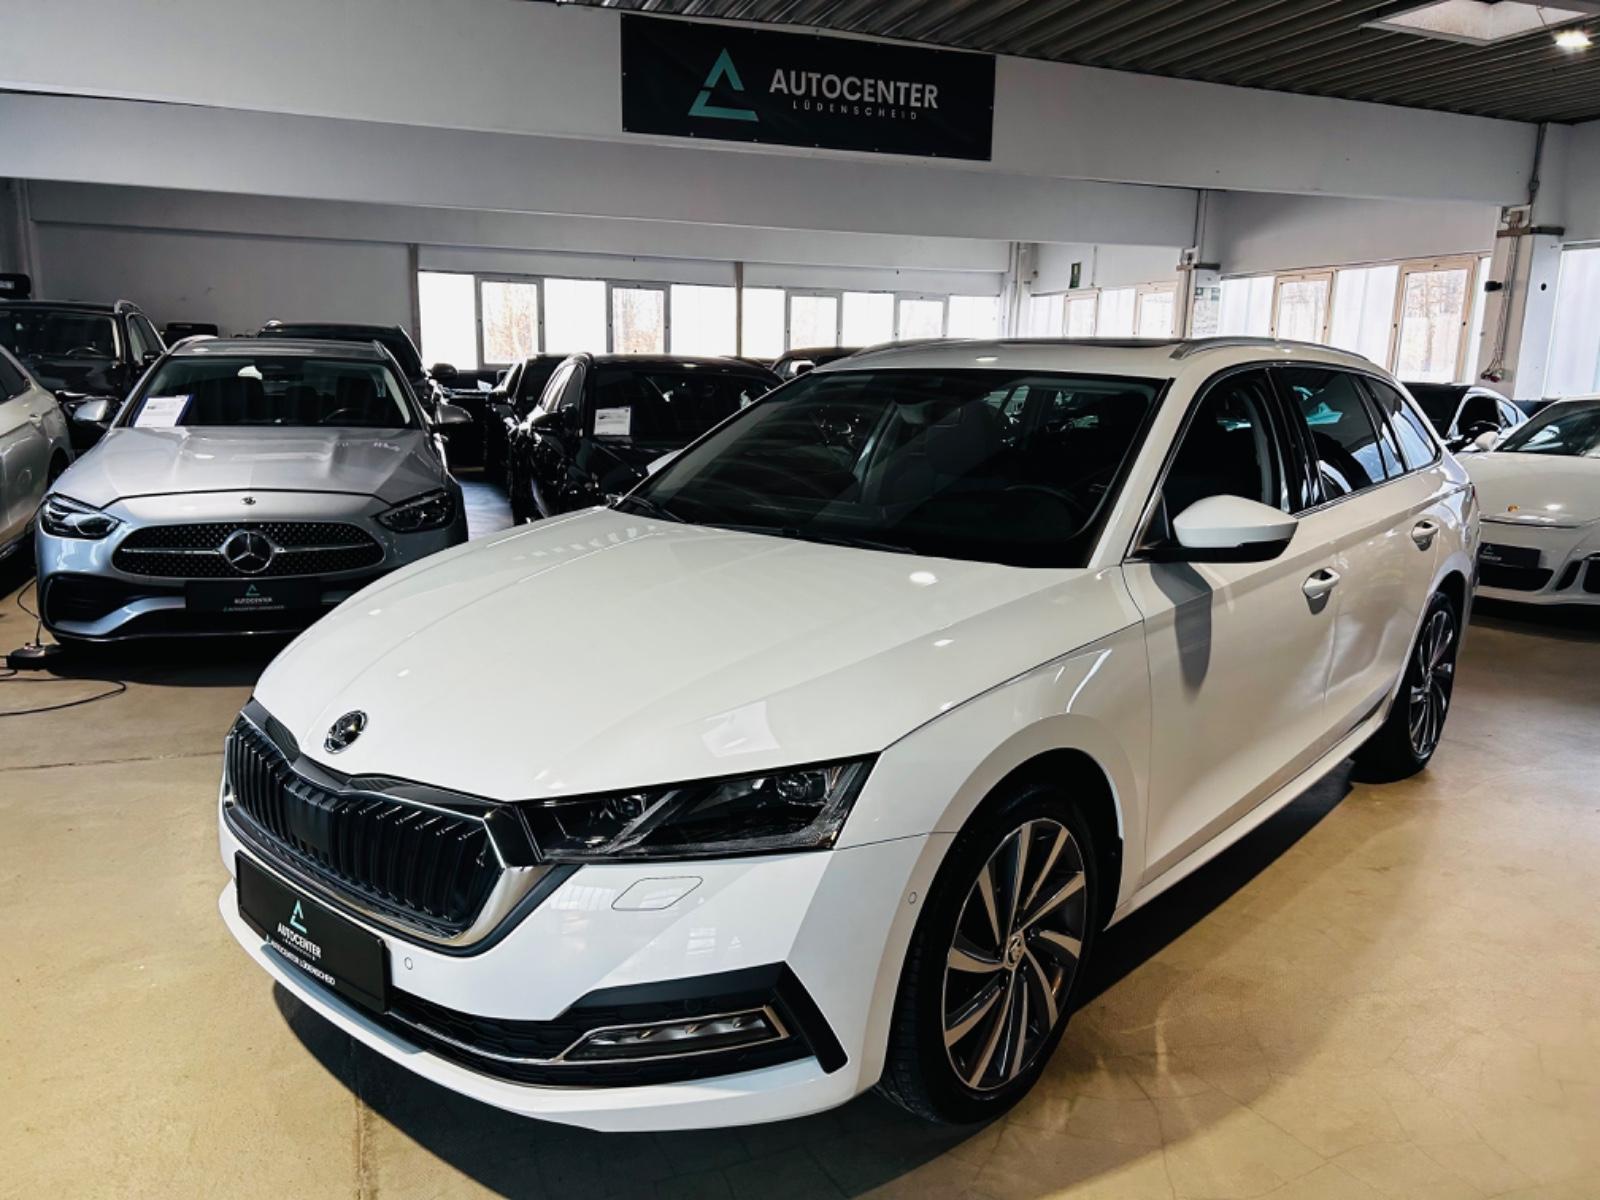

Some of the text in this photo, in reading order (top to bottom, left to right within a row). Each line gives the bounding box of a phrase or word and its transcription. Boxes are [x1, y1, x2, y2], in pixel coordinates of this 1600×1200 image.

[769, 68, 939, 109] AUTOCENTER
[793, 99, 918, 120] LÜDENSCHEID
[277, 922, 321, 959] AUTOCENTER
